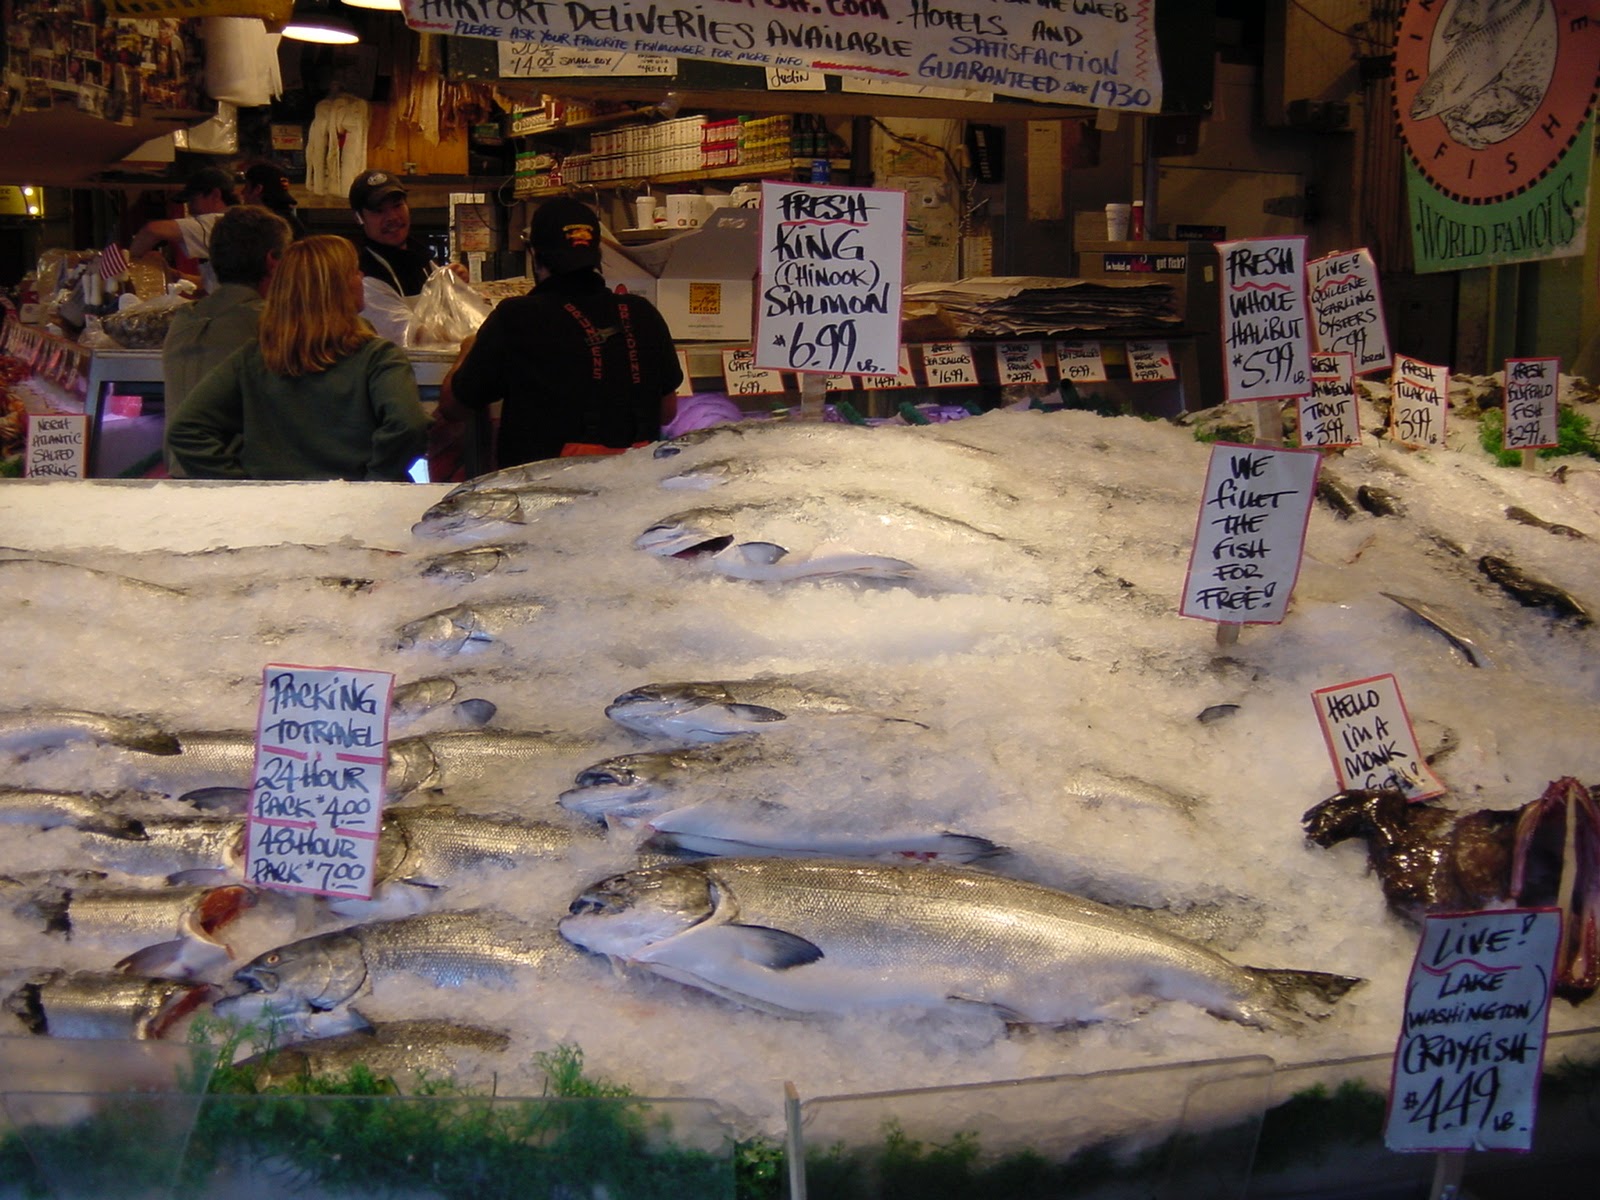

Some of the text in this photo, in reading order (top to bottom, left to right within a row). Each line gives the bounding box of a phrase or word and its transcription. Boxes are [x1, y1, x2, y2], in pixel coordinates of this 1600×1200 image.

[565, 2, 755, 49] DELIVERIES
[766, 20, 912, 57] AVAILABLE
[907, 0, 1083, 46] HOTELS AND
[455, 21, 502, 37] PLEASE
[510, 26, 535, 41] ASK
[541, 29, 571, 46] YOUR
[573, 36, 628, 50] FAVORITE
[635, 39, 705, 56] FISHMONGER
[711, 47, 733, 59] FOR
[737, 52, 770, 63] MORE
[950, 36, 1119, 75] SATISFACTION
[559, 57, 592, 66] SMALL
[918, 54, 1060, 93] GUARANTEED
[1090, 81, 1151, 107] 1930
[777, 190, 880, 223] FRESH
[1418, 172, 1576, 261] WORLD FAMOUS
[771, 223, 864, 262] KING
[1226, 248, 1294, 284] FRESH
[764, 283, 889, 317] SALMON
[1230, 291, 1296, 318] WHOLE
[1226, 316, 1303, 348] HALIBUT
[1319, 309, 1376, 337] OYSTERS
[734, 351, 754, 360] FRES
[1233, 342, 1294, 388] $5.99
[1311, 357, 1340, 374] RESH
[1400, 359, 1436, 381] FRESH
[1512, 362, 1547, 379] FRESH
[1310, 376, 1354, 398] AINBOW
[1394, 381, 1443, 405] TILAPIA
[1508, 382, 1553, 402] BUFFALO
[1303, 400, 1349, 420] TROUT
[1511, 404, 1544, 420] FISH
[38, 418, 72, 432] NORTH
[1305, 423, 1344, 445] $3.99
[32, 432, 82, 447] ATLANTIC
[32, 449, 74, 463] SALTED
[1231, 453, 1274, 480] WE
[27, 463, 77, 478] HERRING
[1211, 514, 1269, 535] THE
[1212, 537, 1271, 559] FISH
[1212, 564, 1263, 581] FOR
[1196, 582, 1277, 610] FREE!
[269, 673, 377, 714] PACKING
[1327, 690, 1379, 723] HELLO
[1375, 716, 1389, 740] A
[1344, 741, 1407, 779] MONK
[254, 757, 369, 793] 24 HOUR
[255, 792, 316, 818] PACK
[257, 825, 358, 859] 48 HOUR
[252, 858, 304, 884] PACK
[1403, 1032, 1538, 1075] CRAYFISH
[1402, 1066, 1499, 1133] $4.49
